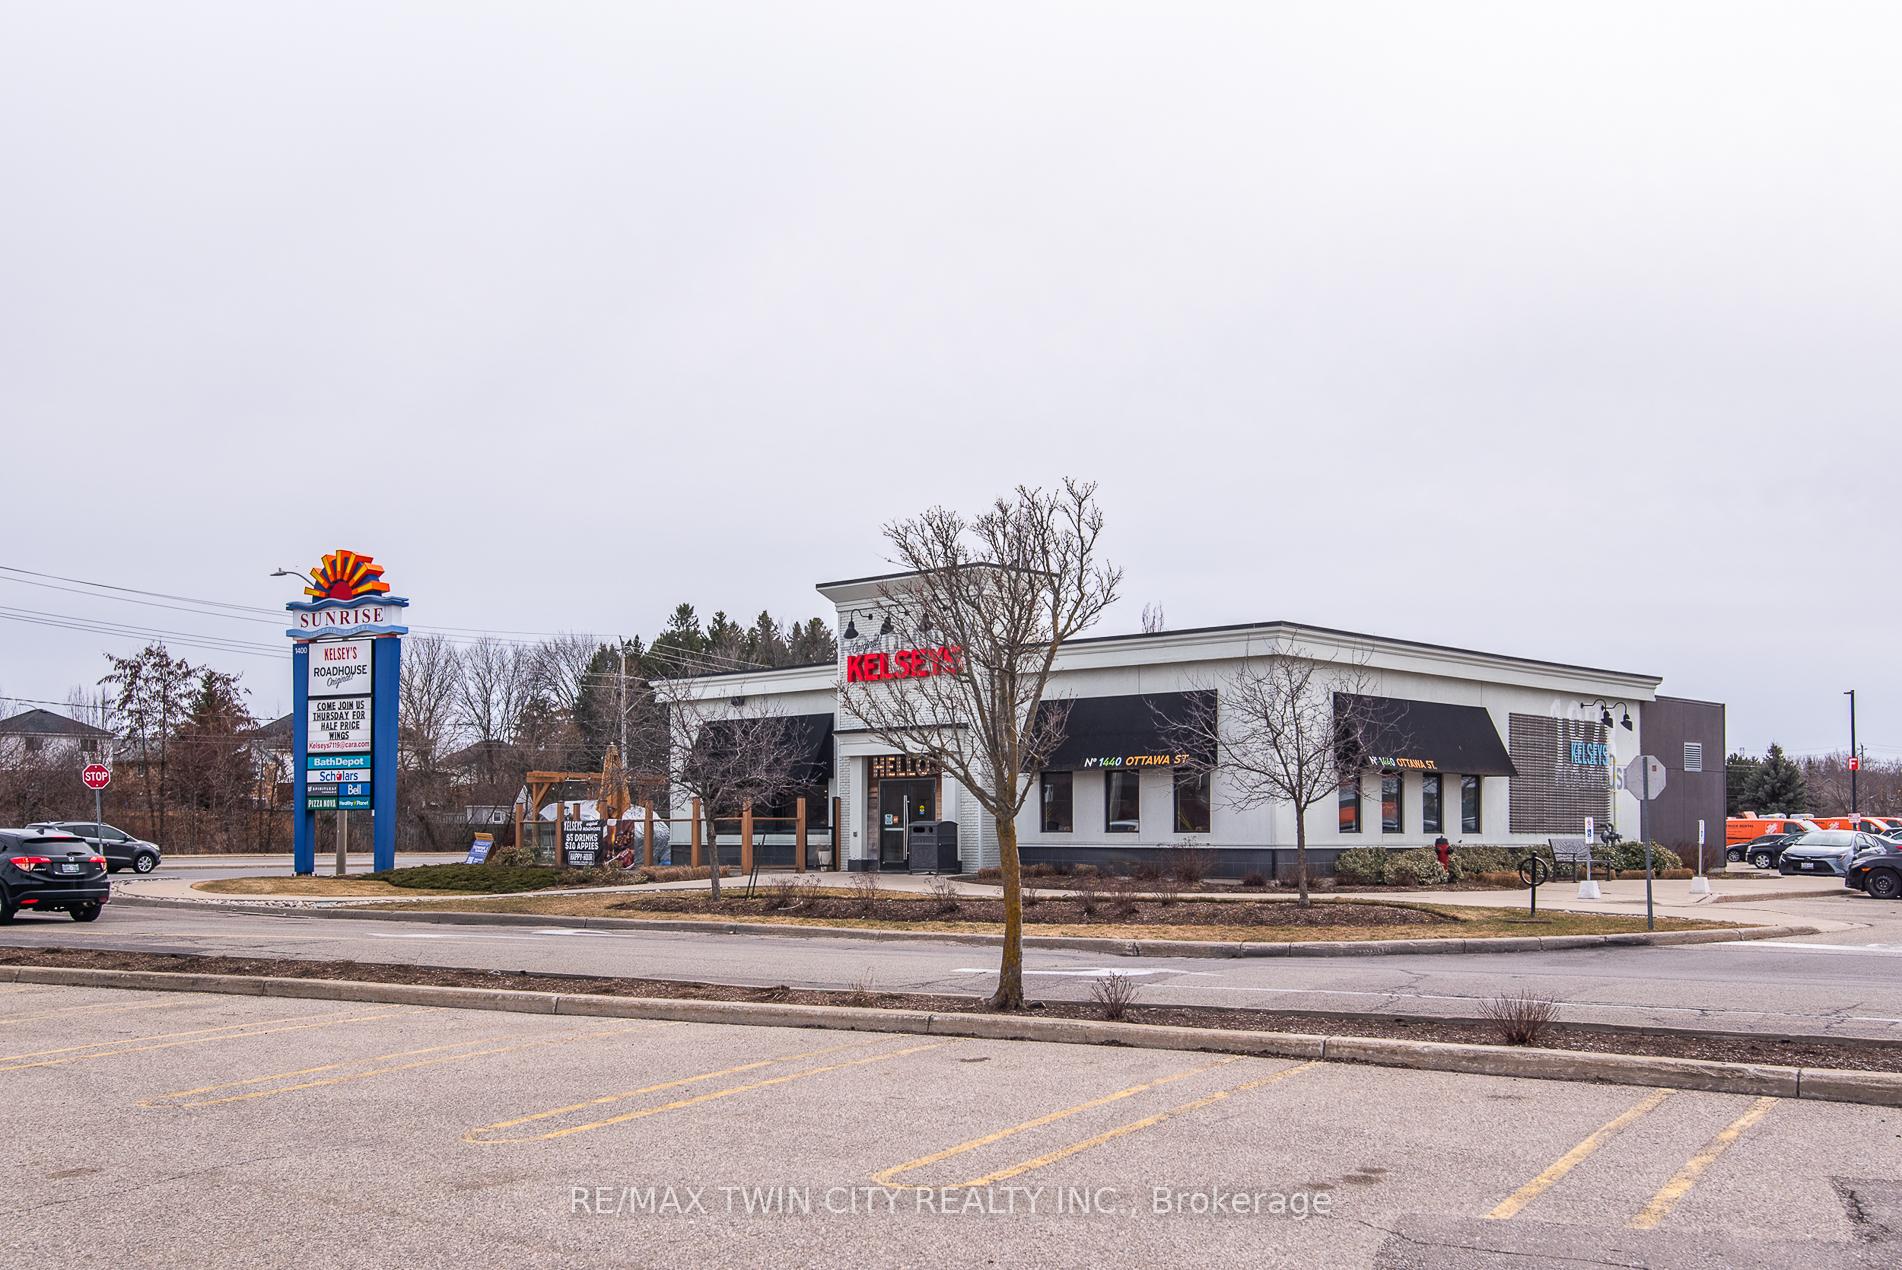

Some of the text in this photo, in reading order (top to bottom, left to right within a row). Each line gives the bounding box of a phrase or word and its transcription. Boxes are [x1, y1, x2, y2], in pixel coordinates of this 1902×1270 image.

[300, 607, 384, 628] SUNRISE
[324, 646, 358, 661] KELSEY'S
[313, 664, 368, 677] ROADHOUSE
[317, 700, 365, 711] COME JOIN US
[313, 710, 366, 721] THURSDAY FOR
[320, 720, 360, 731] HALF PRICE
[329, 731, 349, 740] WINGS
[1099, 757, 1122, 767] 1440
[1125, 754, 1170, 766] OTTAWA
[1396, 758, 1427, 769] OTTAWA
[1849, 758, 1857, 769] F
[873, 756, 930, 777] HELLO
[85, 771, 108, 782] STOP
[347, 783, 362, 795] Bell
[574, 833, 598, 842] DRINKS
[577, 841, 599, 850] APPIES
